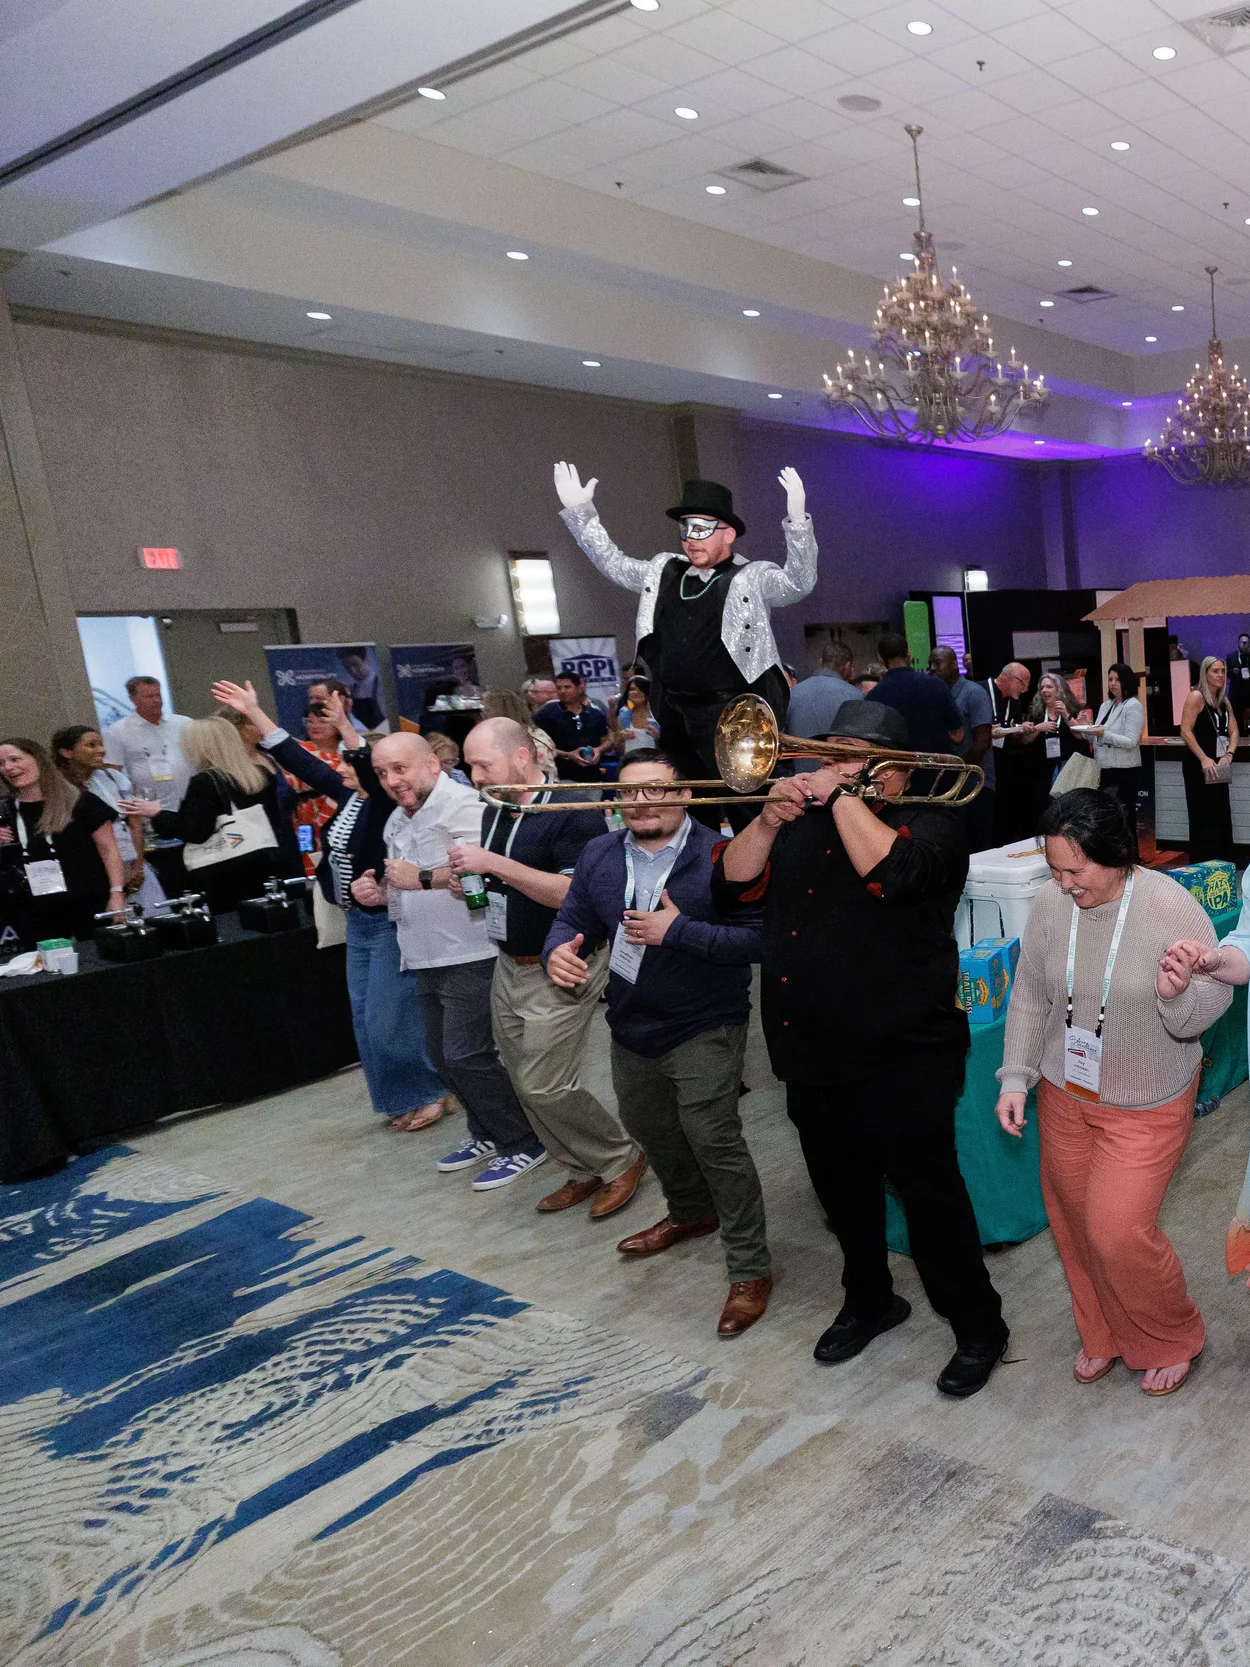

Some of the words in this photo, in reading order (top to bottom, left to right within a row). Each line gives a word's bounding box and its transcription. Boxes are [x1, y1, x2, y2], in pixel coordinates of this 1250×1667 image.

[1122, 890, 1132, 910] Littler
[1208, 892, 1228, 908] IPA
[1115, 920, 1124, 938] Littler
[1108, 948, 1116, 968] Littler
[962, 972, 970, 994] TRAIL
[965, 996, 974, 1014] PASS
